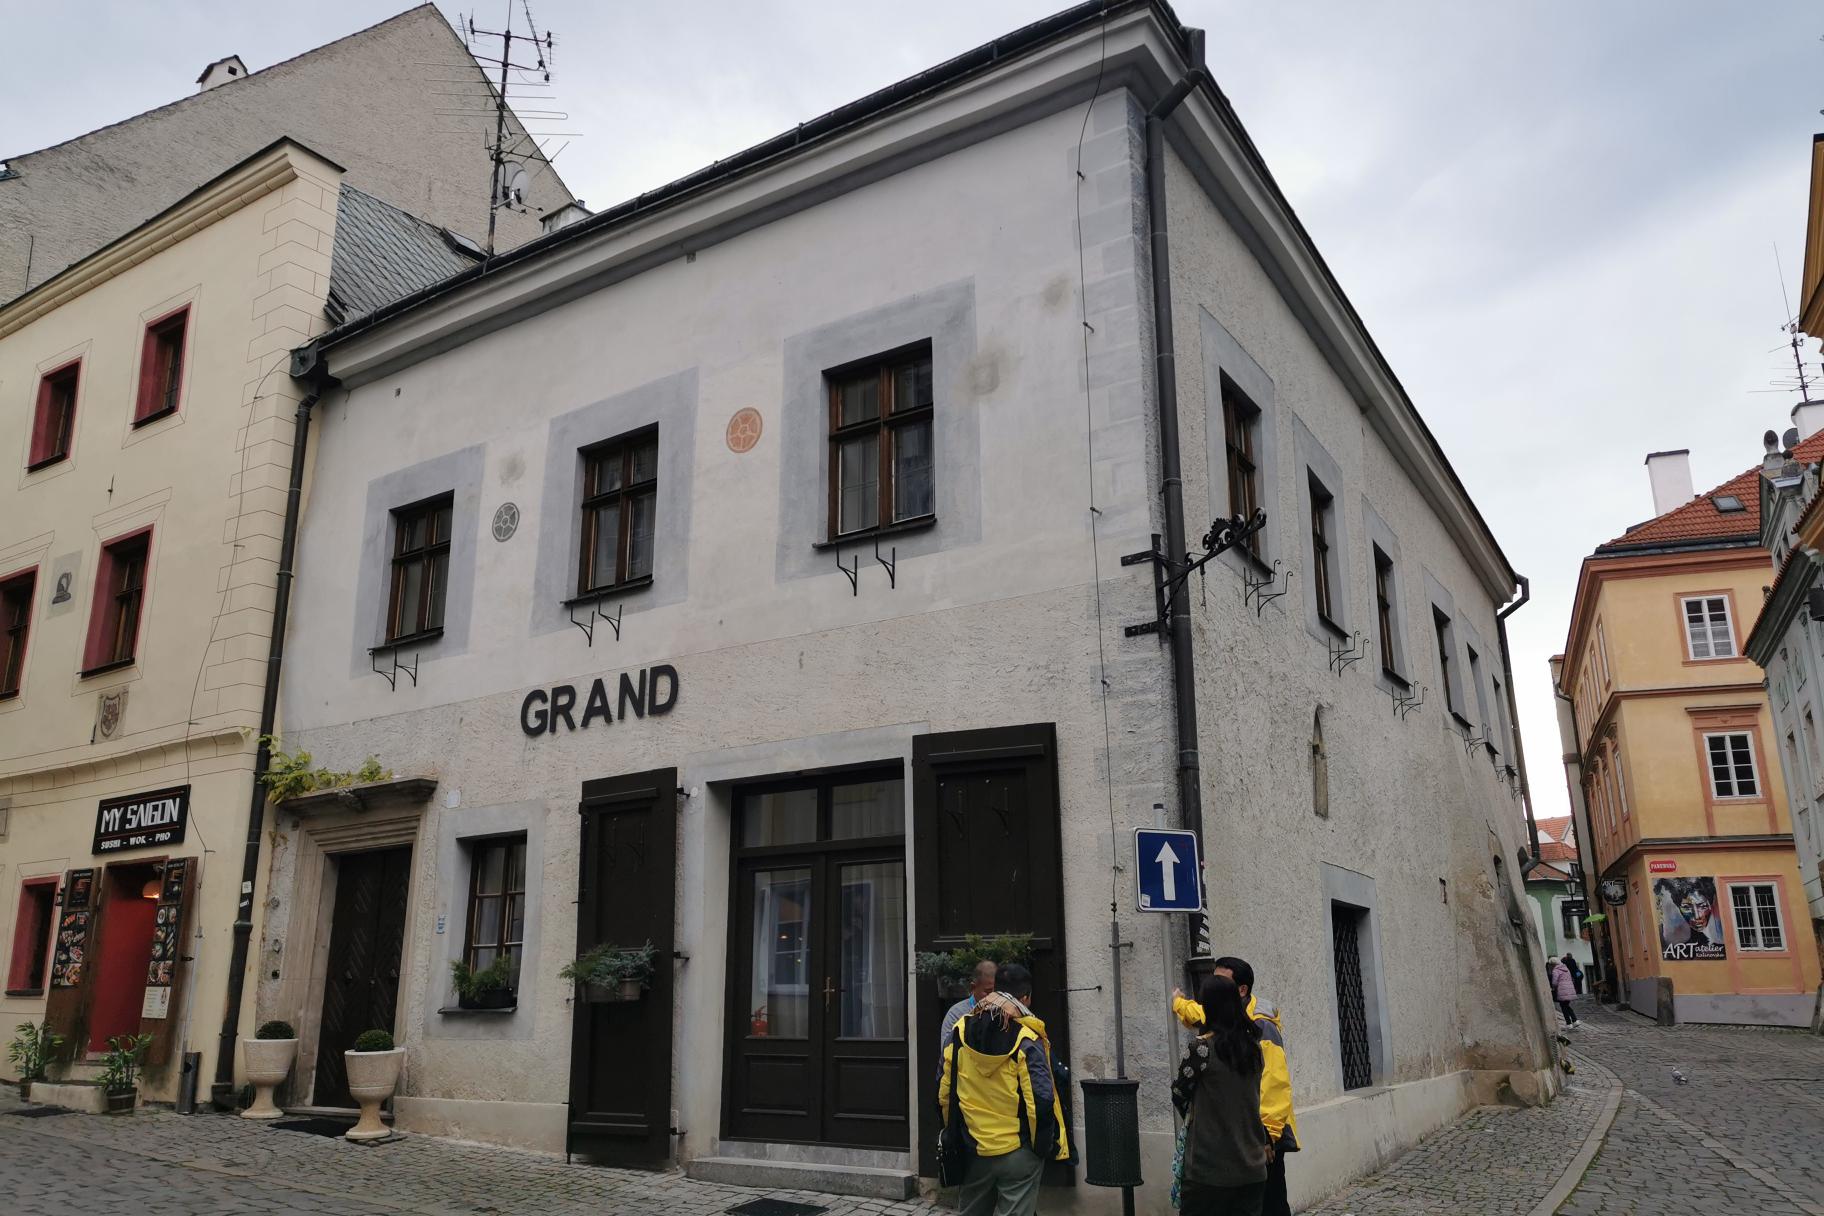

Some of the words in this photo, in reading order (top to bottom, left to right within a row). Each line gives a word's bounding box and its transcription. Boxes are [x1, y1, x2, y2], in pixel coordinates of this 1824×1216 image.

[520, 664, 679, 738] GRAND
[100, 807, 124, 833] MY
[125, 797, 180, 829] SAIGON
[100, 839, 121, 850] SUSHI
[129, 835, 146, 845] WOK
[155, 832, 171, 842] PHO
[1663, 942, 1698, 960] ART
[1695, 944, 1724, 953] atelier
